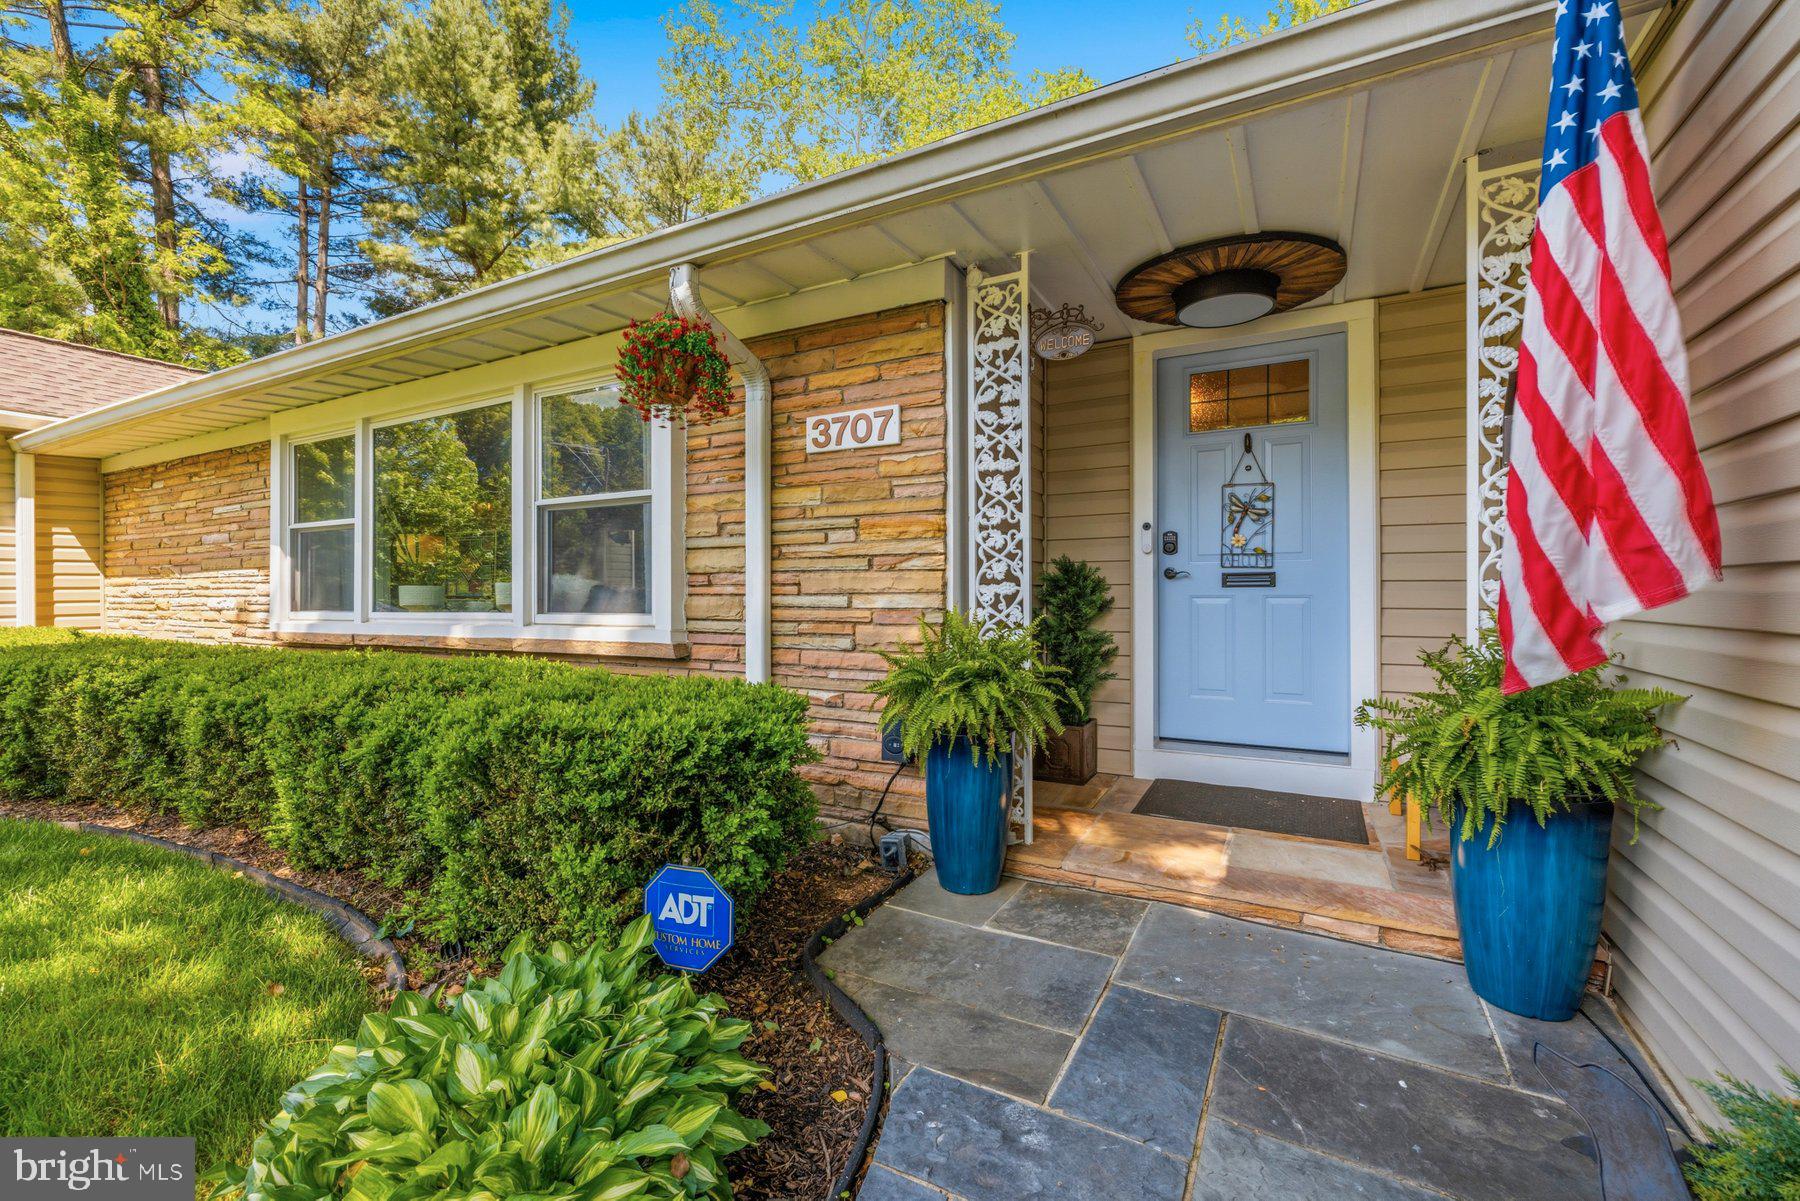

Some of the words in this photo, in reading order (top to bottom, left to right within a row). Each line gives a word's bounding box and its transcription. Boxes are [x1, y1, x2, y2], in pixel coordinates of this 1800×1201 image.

[1040, 333, 1090, 352] WELCOME
[812, 409, 893, 449] 3707
[658, 892, 714, 927] ADT
[655, 931, 688, 946] USTOM
[691, 937, 721, 950] HOME
